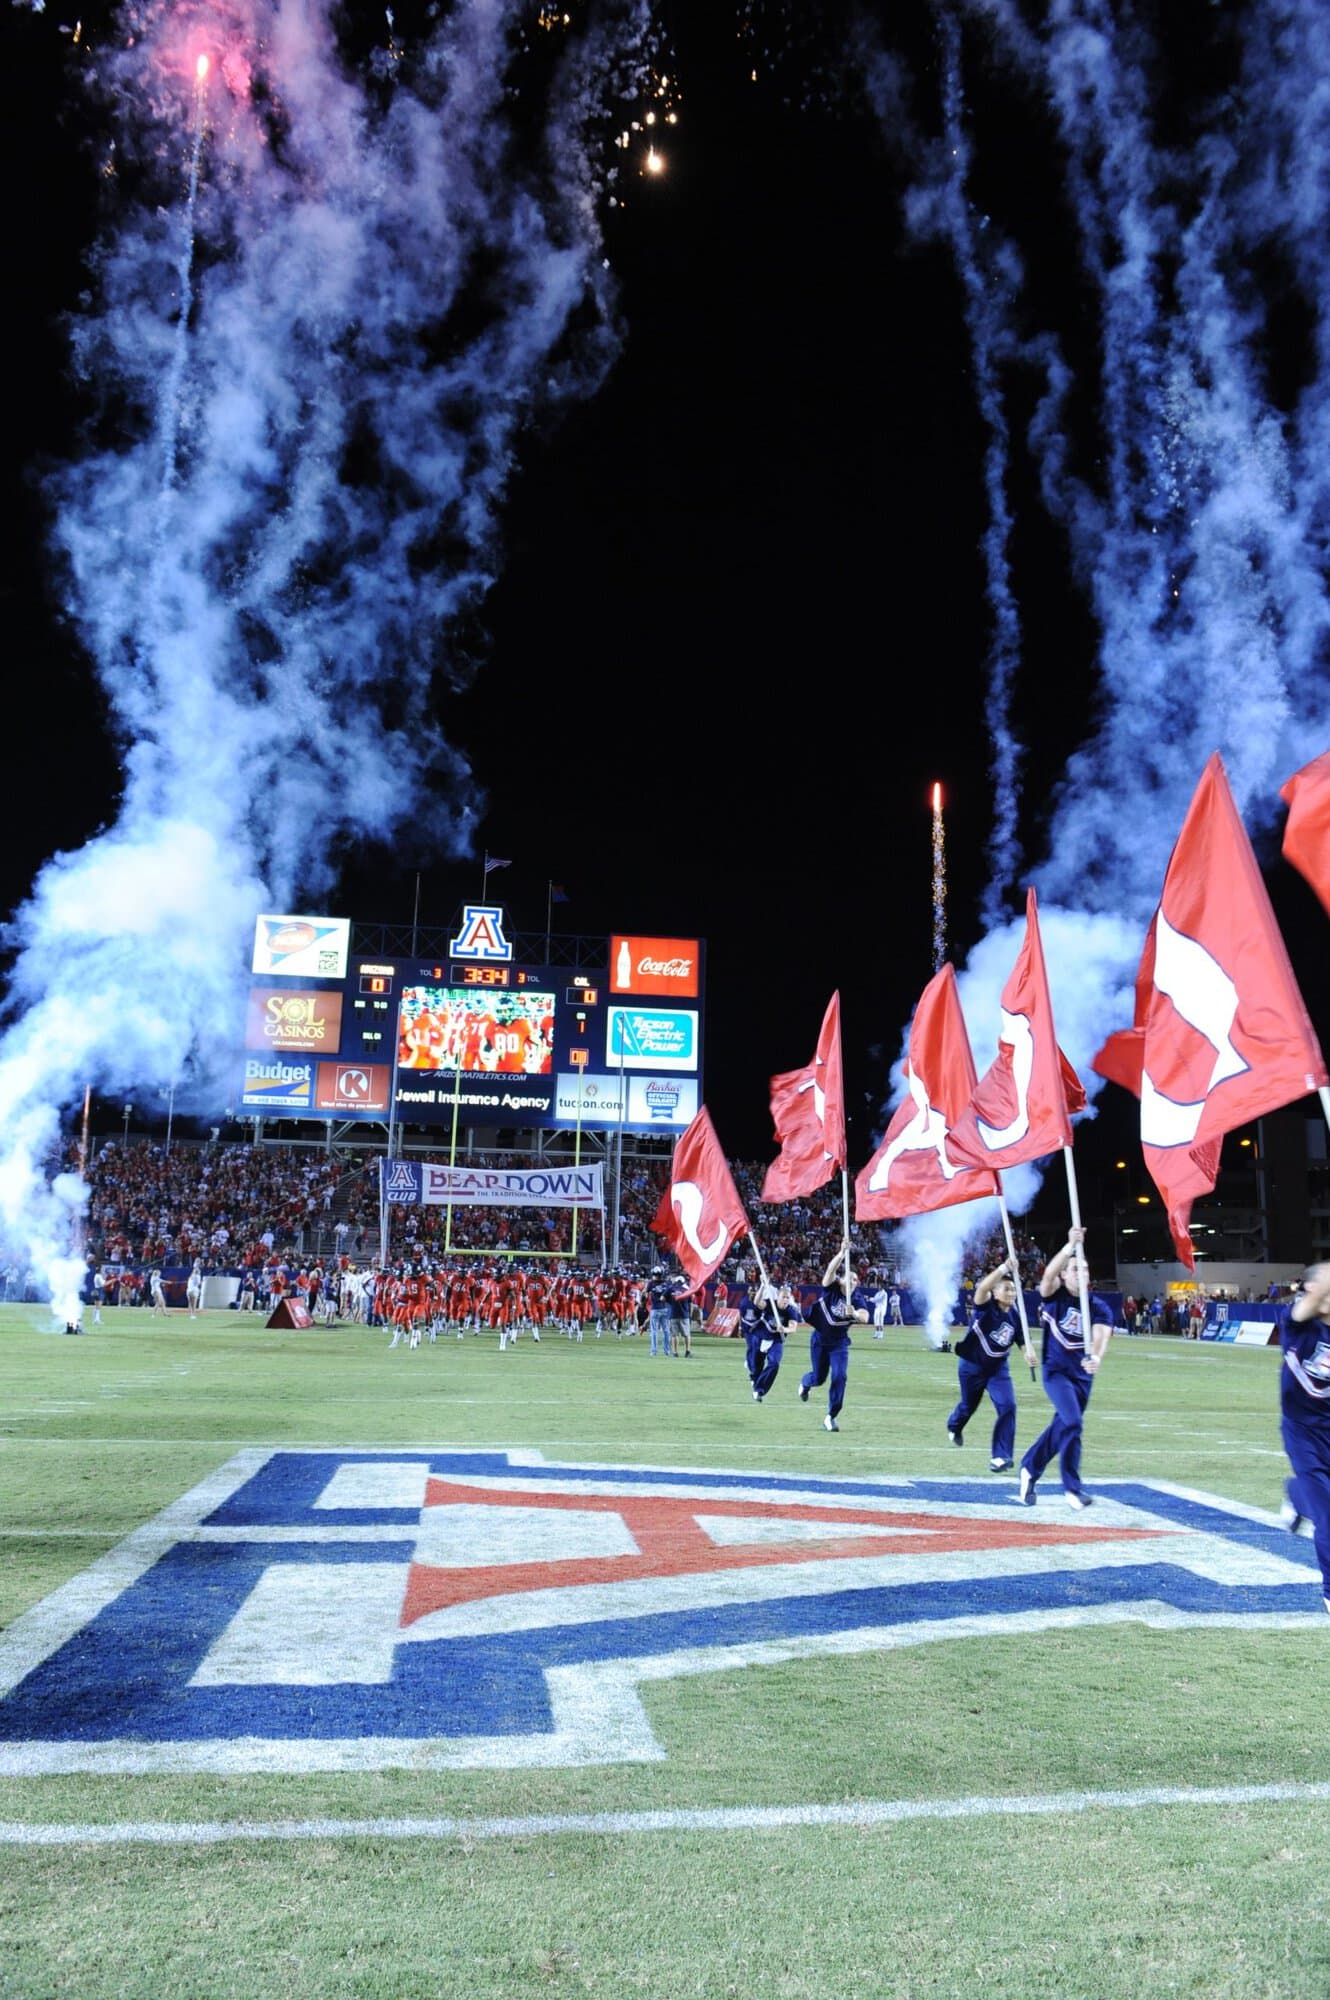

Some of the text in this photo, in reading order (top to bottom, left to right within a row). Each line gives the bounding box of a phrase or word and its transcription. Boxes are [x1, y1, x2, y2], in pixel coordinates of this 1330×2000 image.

[450, 906, 512, 960] A
[420, 968, 442, 979] TOL 3
[464, 967, 508, 985] 3:34
[518, 973, 540, 984] 3 TOL
[371, 979, 384, 992] 0
[584, 990, 596, 1004] 0
[265, 996, 325, 1026] SOL
[633, 1015, 675, 1030] Tucson
[264, 1023, 325, 1040] CASINOS
[637, 1027, 686, 1042] Electric
[641, 1039, 685, 1052] Power
[245, 1060, 311, 1084] Budget
[395, 1089, 550, 1110] Jewell Insurance Agency
[386, 1161, 416, 1190] A
[506, 1173, 594, 1194] DOWN
[387, 1191, 416, 1201] CLUB
